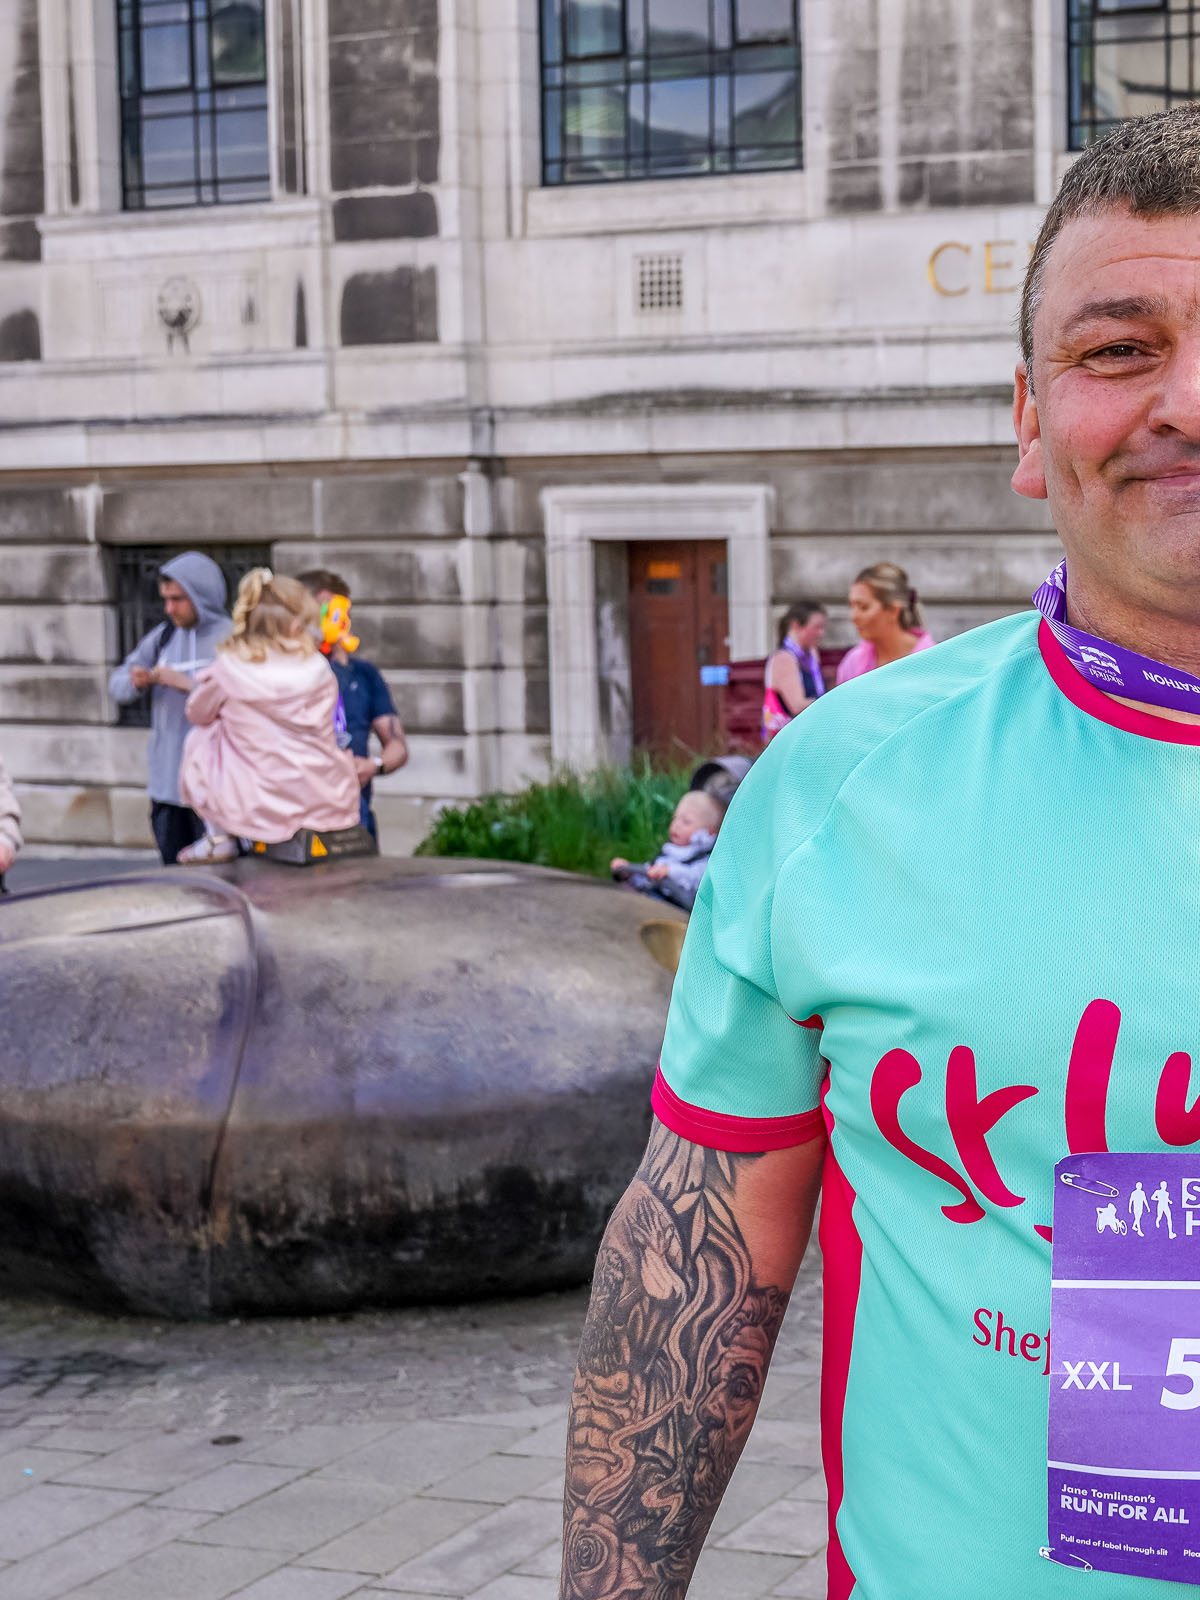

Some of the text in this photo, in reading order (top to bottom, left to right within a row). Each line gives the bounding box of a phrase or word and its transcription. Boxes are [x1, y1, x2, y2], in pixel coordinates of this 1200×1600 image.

[927, 240, 1036, 297] CE
[870, 1045, 1039, 1223] St
[1060, 1361, 1133, 1391] XXL
[1060, 1494, 1190, 1524] RUN FOR ALL
[1061, 1484, 1156, 1504] Jane Tomlinson's
[1060, 1533, 1075, 1543] Pull
[1075, 1538, 1091, 1546] end
[1102, 1541, 1122, 1551] label
[1123, 1544, 1155, 1556] through
[1156, 1548, 1168, 1556] slit
